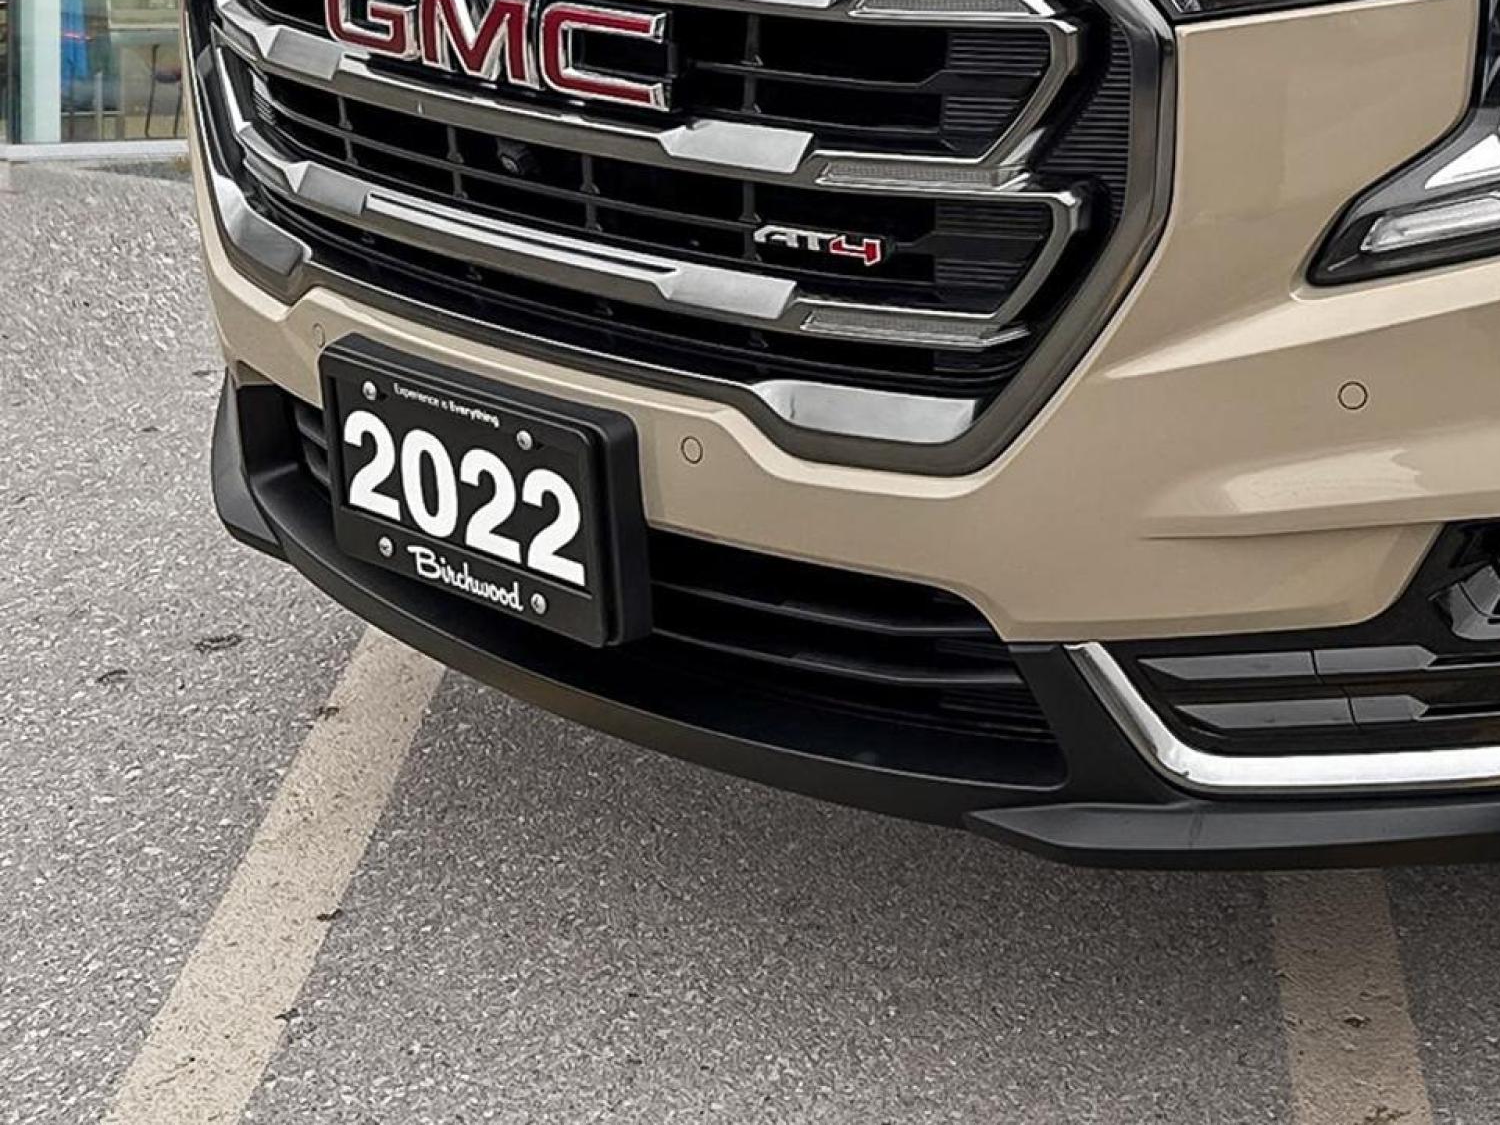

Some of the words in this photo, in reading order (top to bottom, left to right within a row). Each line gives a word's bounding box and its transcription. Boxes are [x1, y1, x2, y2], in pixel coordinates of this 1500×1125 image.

[754, 224, 881, 267] AT4
[343, 410, 586, 587] 2022
[407, 544, 524, 611] Birchwood
